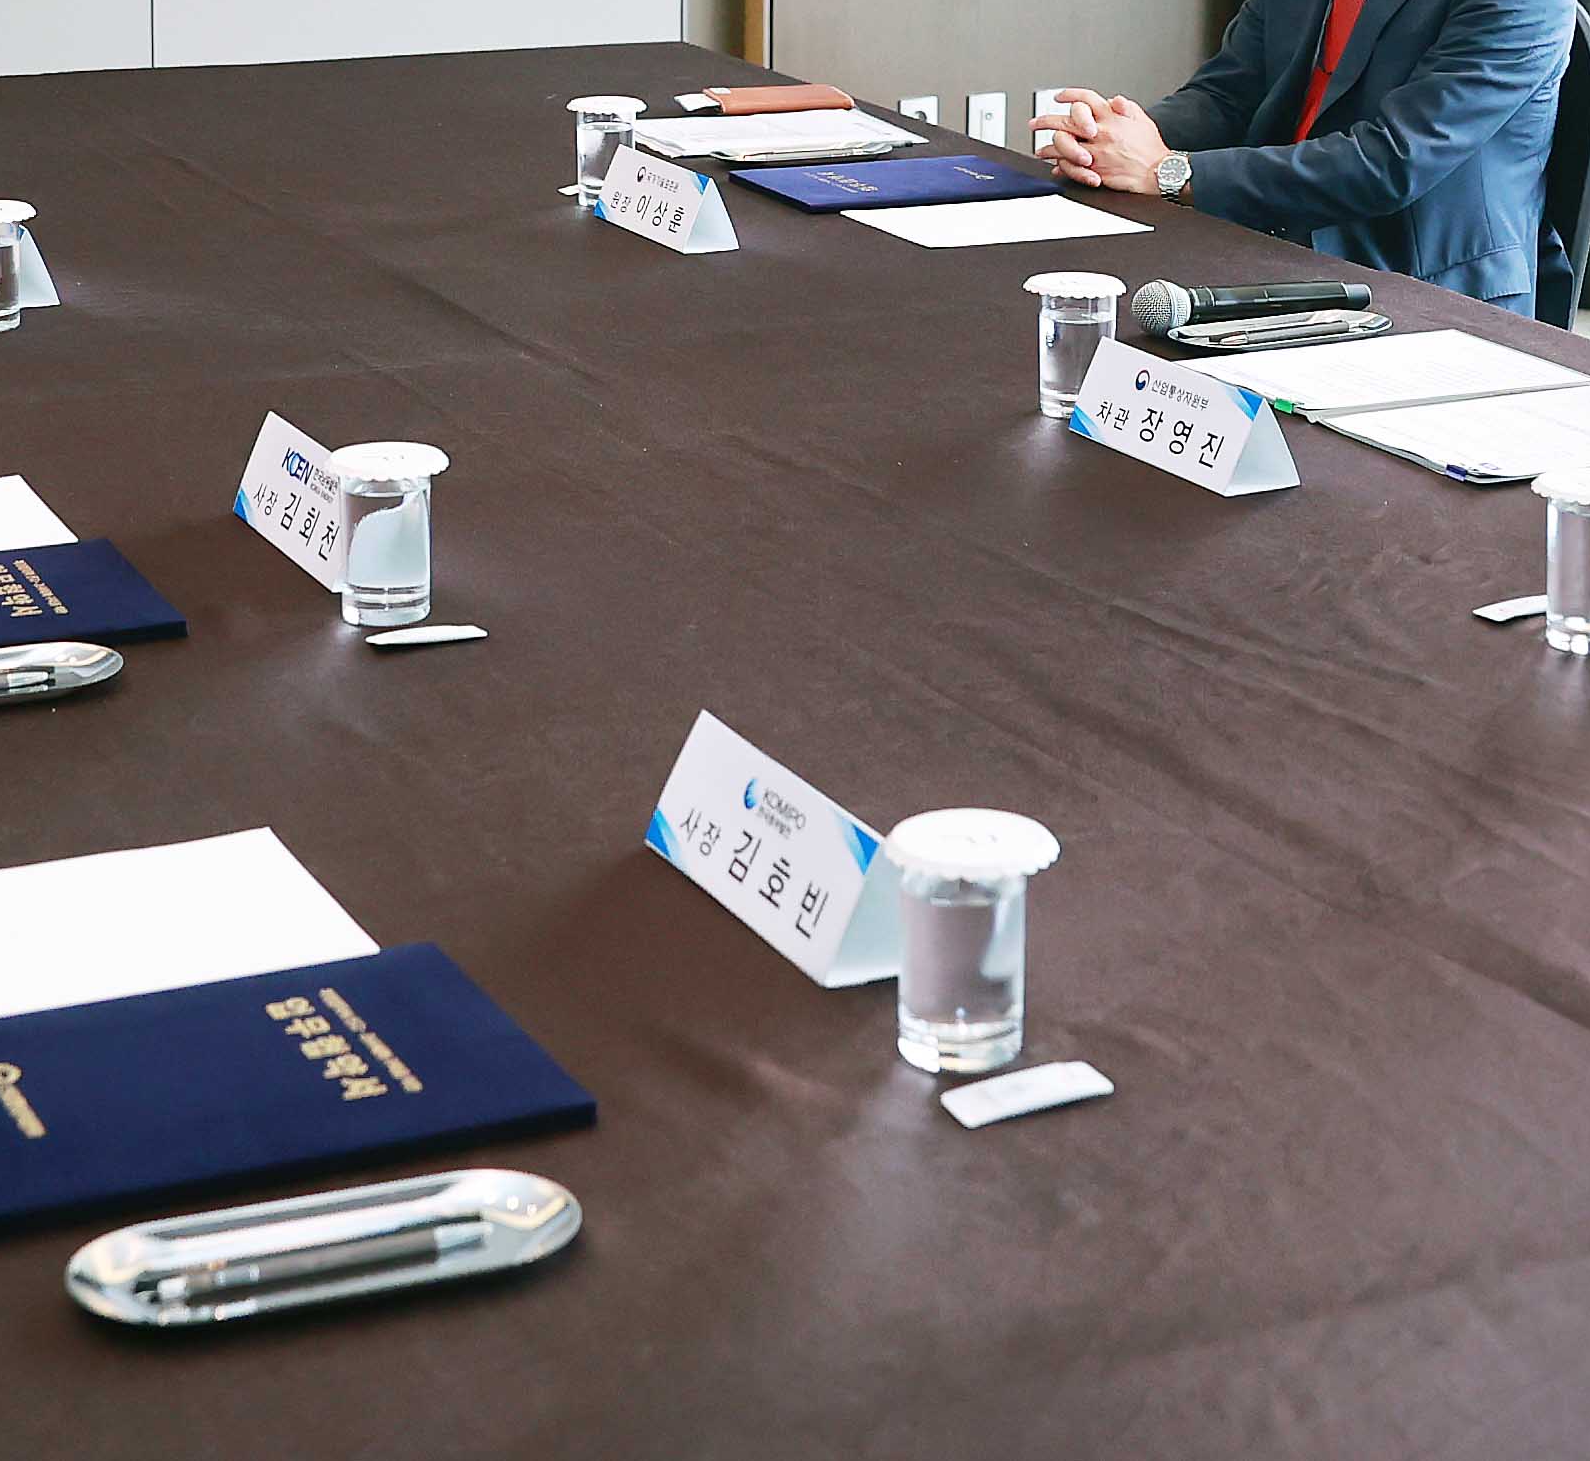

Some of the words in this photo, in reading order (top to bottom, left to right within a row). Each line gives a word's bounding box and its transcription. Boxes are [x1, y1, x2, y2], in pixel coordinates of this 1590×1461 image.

[1151, 379, 1210, 411] 산업통상자원부
[1096, 401, 1130, 431] 차관
[253, 483, 278, 516] 사장
[679, 808, 722, 857] 사장
